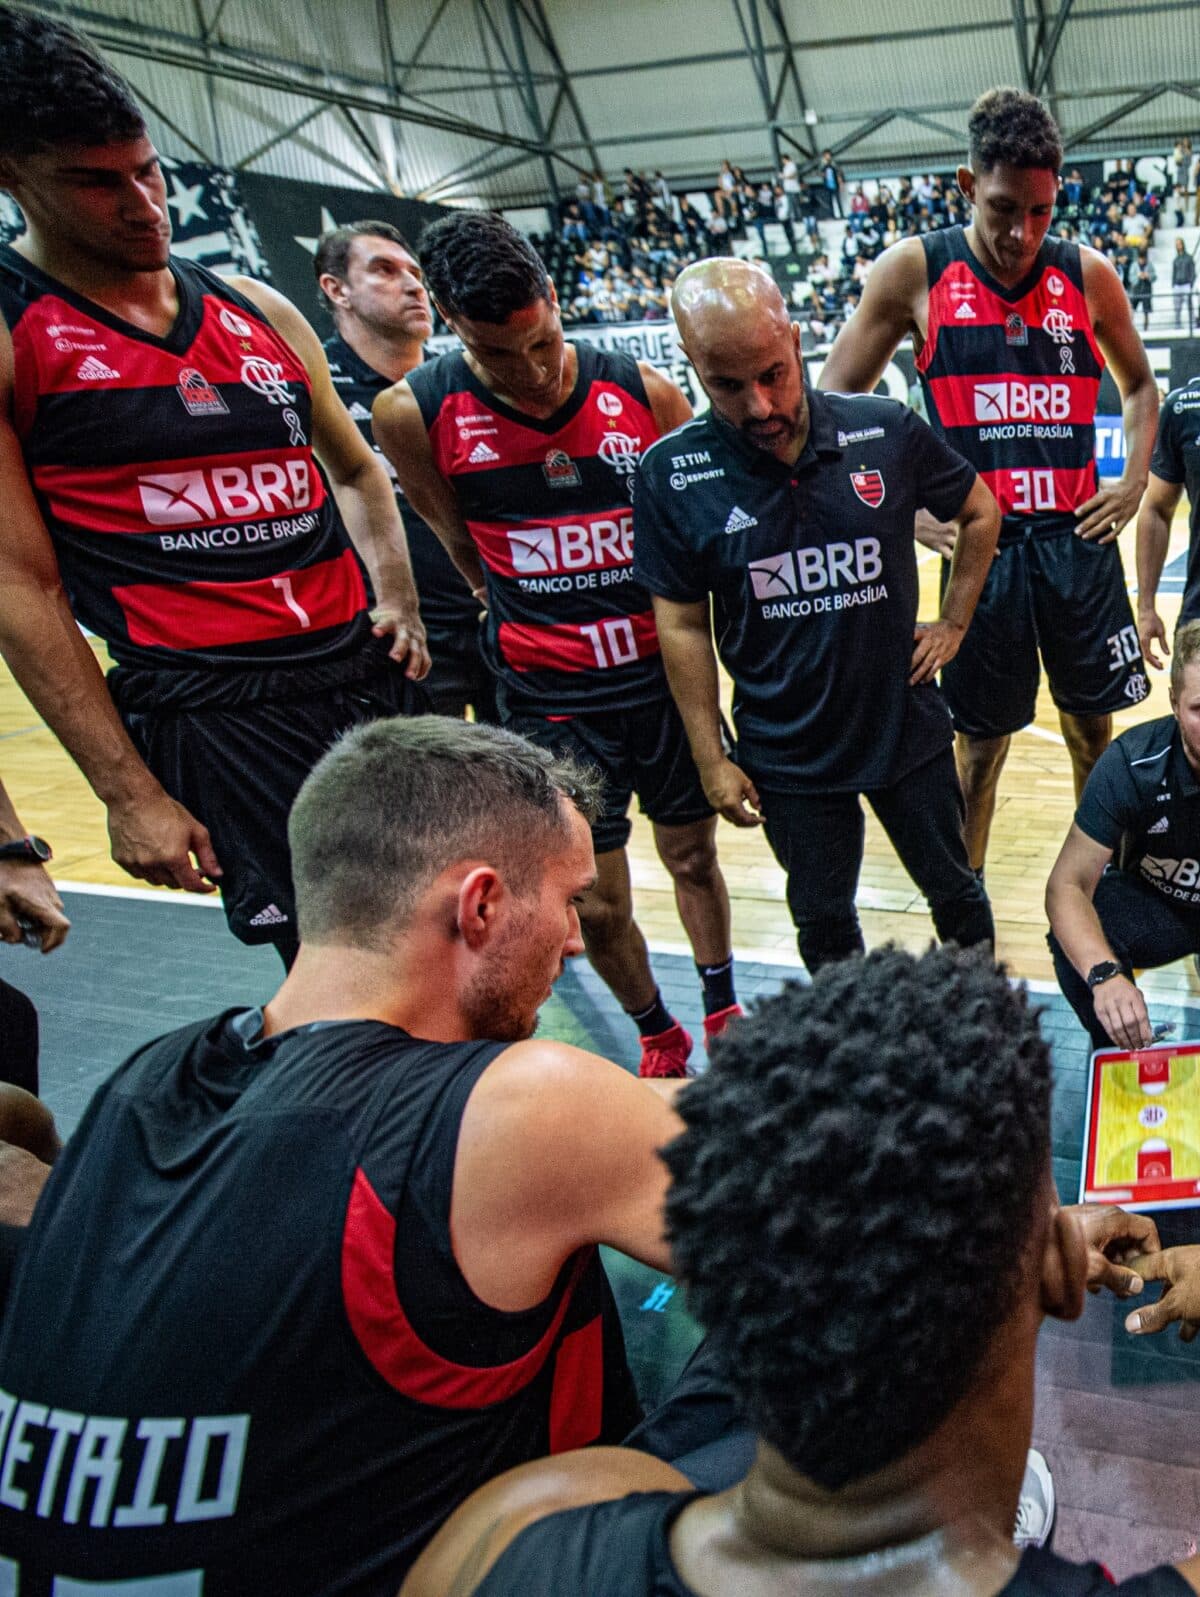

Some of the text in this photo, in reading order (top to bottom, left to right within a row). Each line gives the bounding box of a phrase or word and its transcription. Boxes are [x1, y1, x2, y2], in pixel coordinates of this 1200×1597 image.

[1010, 381, 1071, 421] BRB
[979, 426, 1016, 441] BANCO
[1017, 425, 1032, 438] DE
[685, 451, 712, 466] TIM
[686, 468, 726, 483] ESPORTE
[211, 459, 310, 518] BRB
[1010, 471, 1057, 511] 30
[160, 526, 240, 552] BANCO
[244, 522, 271, 543] DE
[518, 575, 573, 594] BANCO
[575, 573, 598, 590] DE
[796, 537, 883, 593] BRB
[272, 577, 311, 628] 1
[762, 584, 889, 620] BANCO DE BRASÍLIA
[580, 618, 639, 669] 10
[1106, 624, 1142, 672] 30
[1173, 889, 1191, 902] DE
